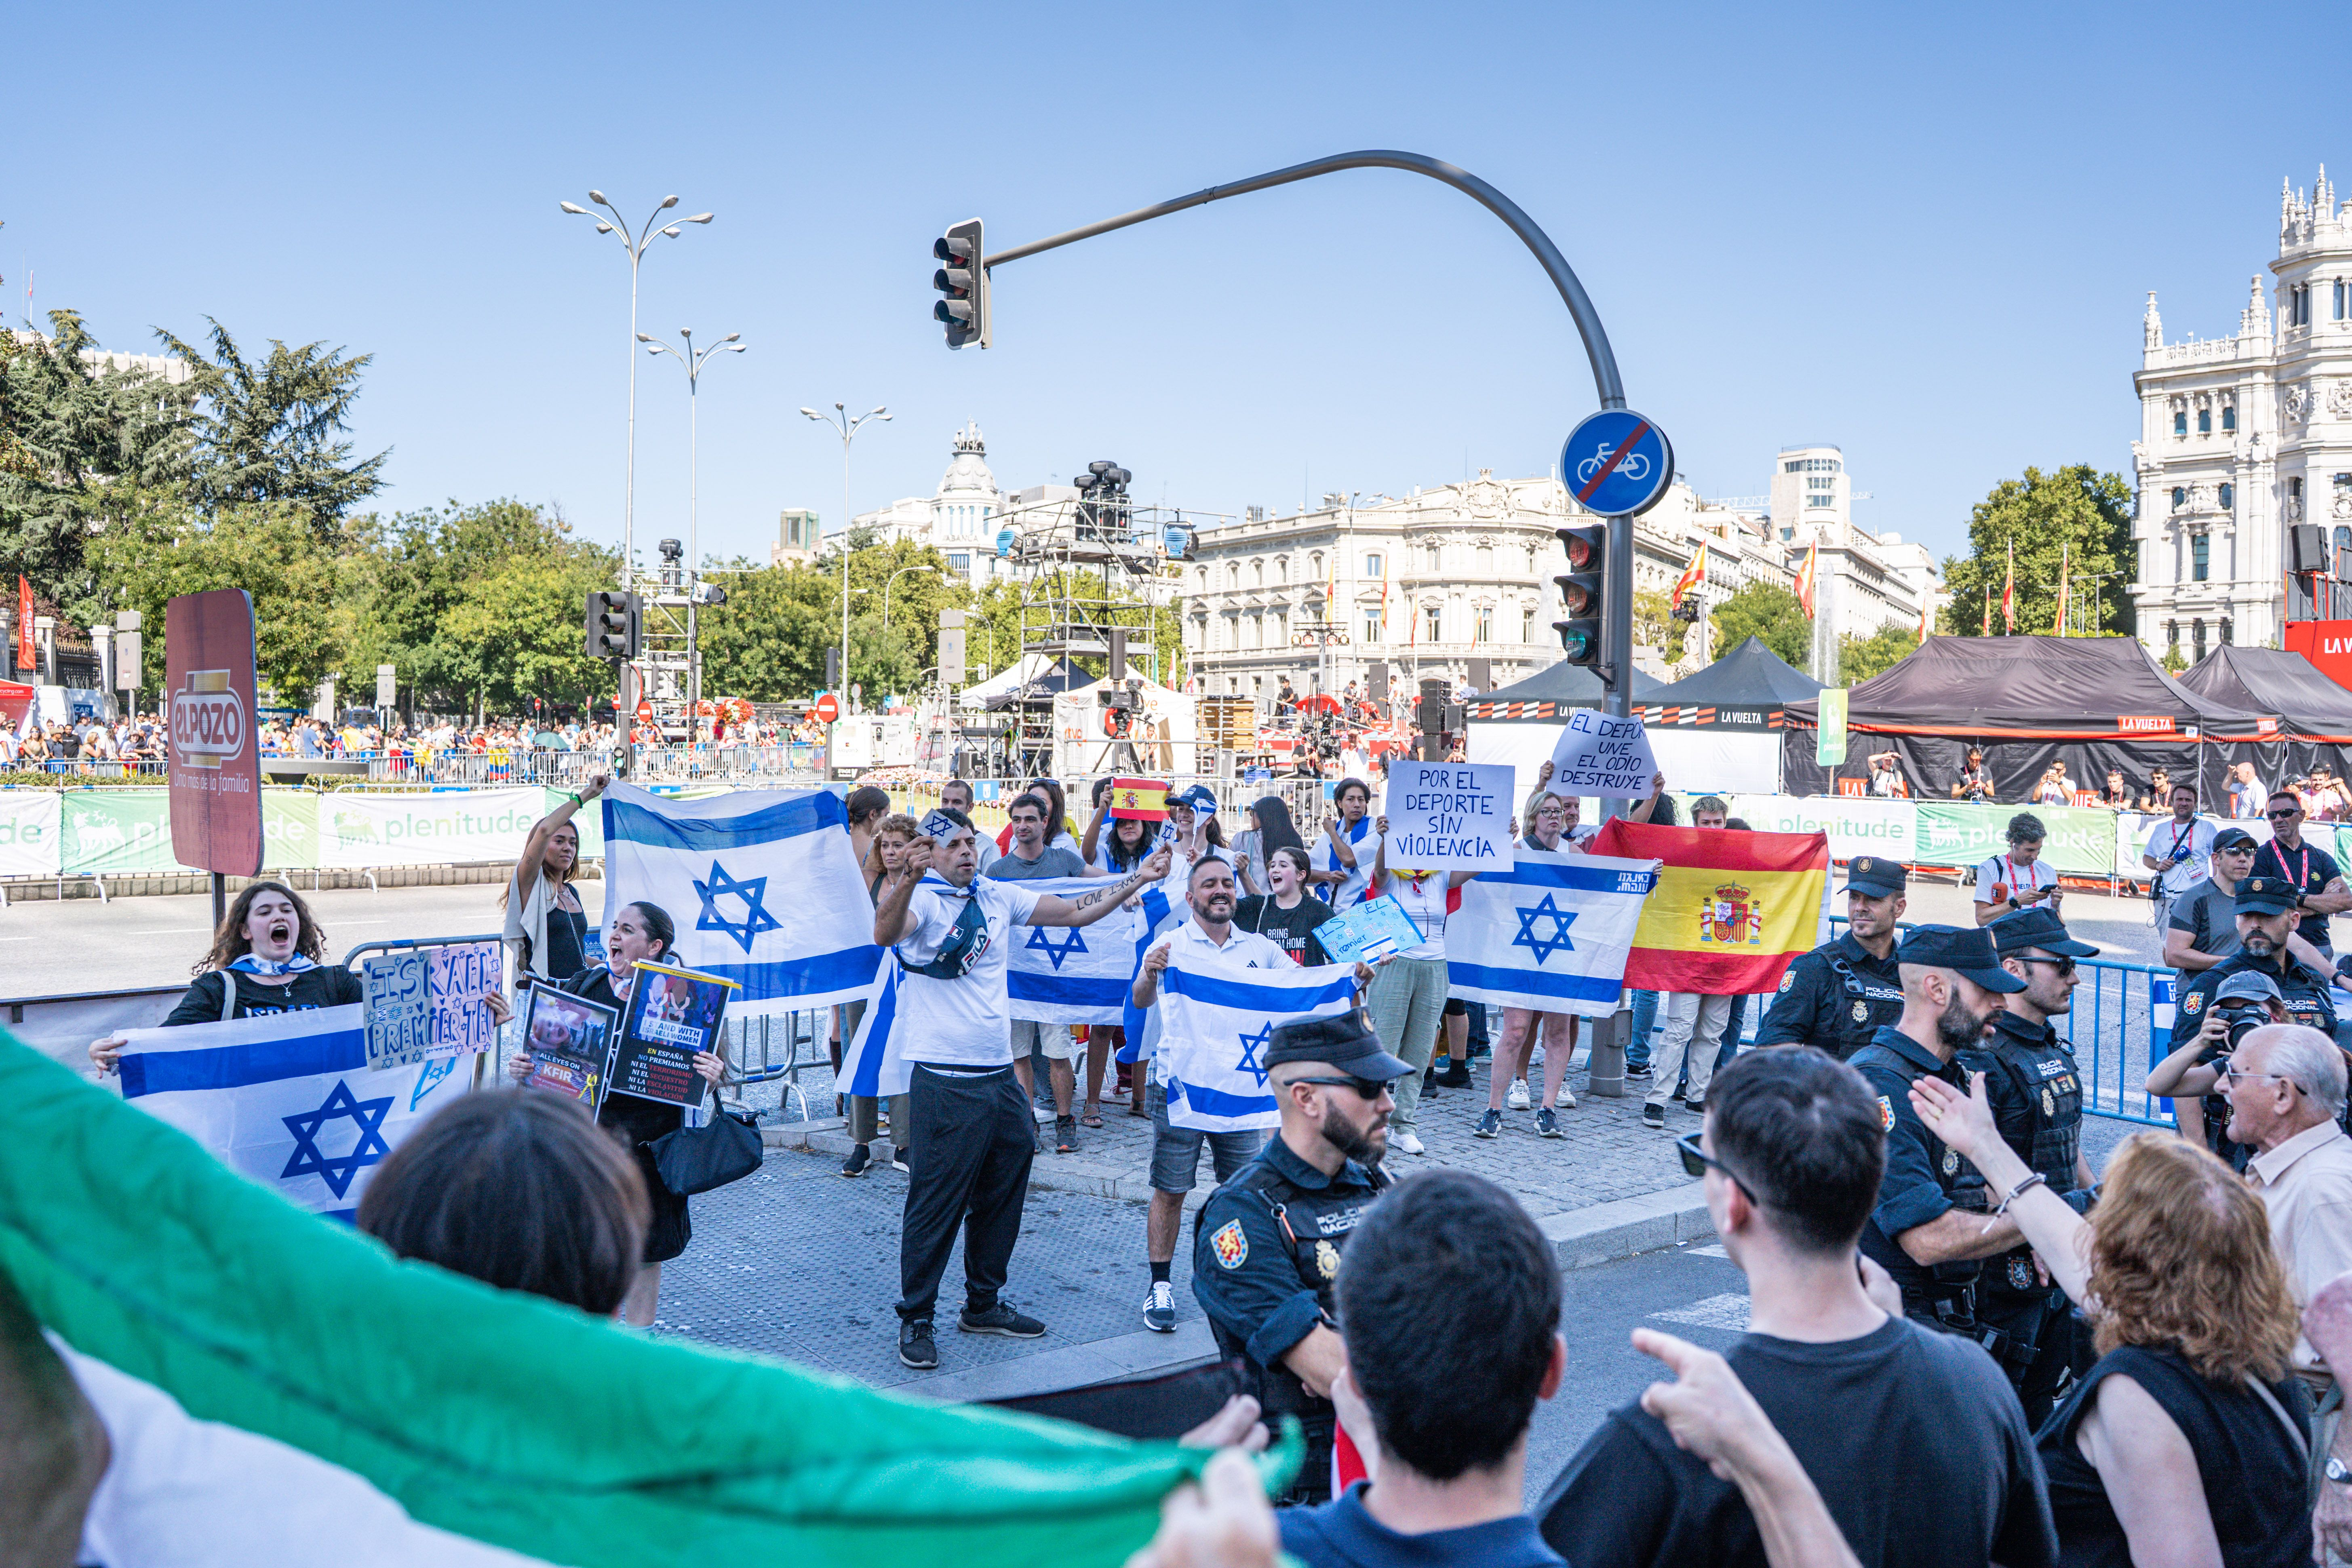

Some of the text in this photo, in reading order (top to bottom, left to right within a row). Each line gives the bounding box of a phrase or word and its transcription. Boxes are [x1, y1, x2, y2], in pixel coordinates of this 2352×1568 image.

[2325, 638, 2342, 653] LA
[1571, 714, 1591, 734] EL
[1721, 711, 1762, 724] LA VUELTA
[2122, 718, 2171, 730] LA VUELTA
[1598, 742, 1633, 755] UNE
[1823, 742, 1843, 753] plenitude
[1577, 754, 1599, 768] EL
[174, 768, 249, 796] Uno más de la familia
[1419, 770, 1481, 790] POR EL
[1561, 770, 1646, 790] DESTRUYE
[1406, 794, 1494, 815] DEPORTE
[386, 809, 533, 845] plenitude
[1779, 815, 1904, 839] plenitude
[1076, 889, 1104, 910] LOVE
[1314, 900, 1388, 939] ISRAEL
[1267, 928, 1288, 939] BRING
[1327, 919, 1400, 957] Premier Tech
[964, 934, 987, 967] FILA
[1286, 937, 1306, 949] HOME
[371, 952, 491, 1009] ISRAEL
[1865, 986, 1899, 995] POLICIA
[1865, 992, 1905, 1001] NACIONAL
[642, 1027, 699, 1044] ISRAELI WOMEN
[649, 1020, 676, 1032] STAND
[678, 1026, 700, 1038] WITH
[540, 1052, 580, 1070] ALL EYES ON
[649, 1056, 690, 1070] PREMIAMOS
[657, 1050, 684, 1061] ESPAÑA
[543, 1064, 573, 1083] KFIR
[649, 1064, 693, 1079] TERRORISMO
[649, 1073, 688, 1086] SECUESTRO
[542, 1078, 561, 1088] youngest
[561, 1084, 578, 1093] prisoner
[647, 1080, 688, 1094] ESCLAVITUD
[647, 1089, 684, 1101] VIOLACIÓN
[1316, 1207, 1359, 1224] POLICI
